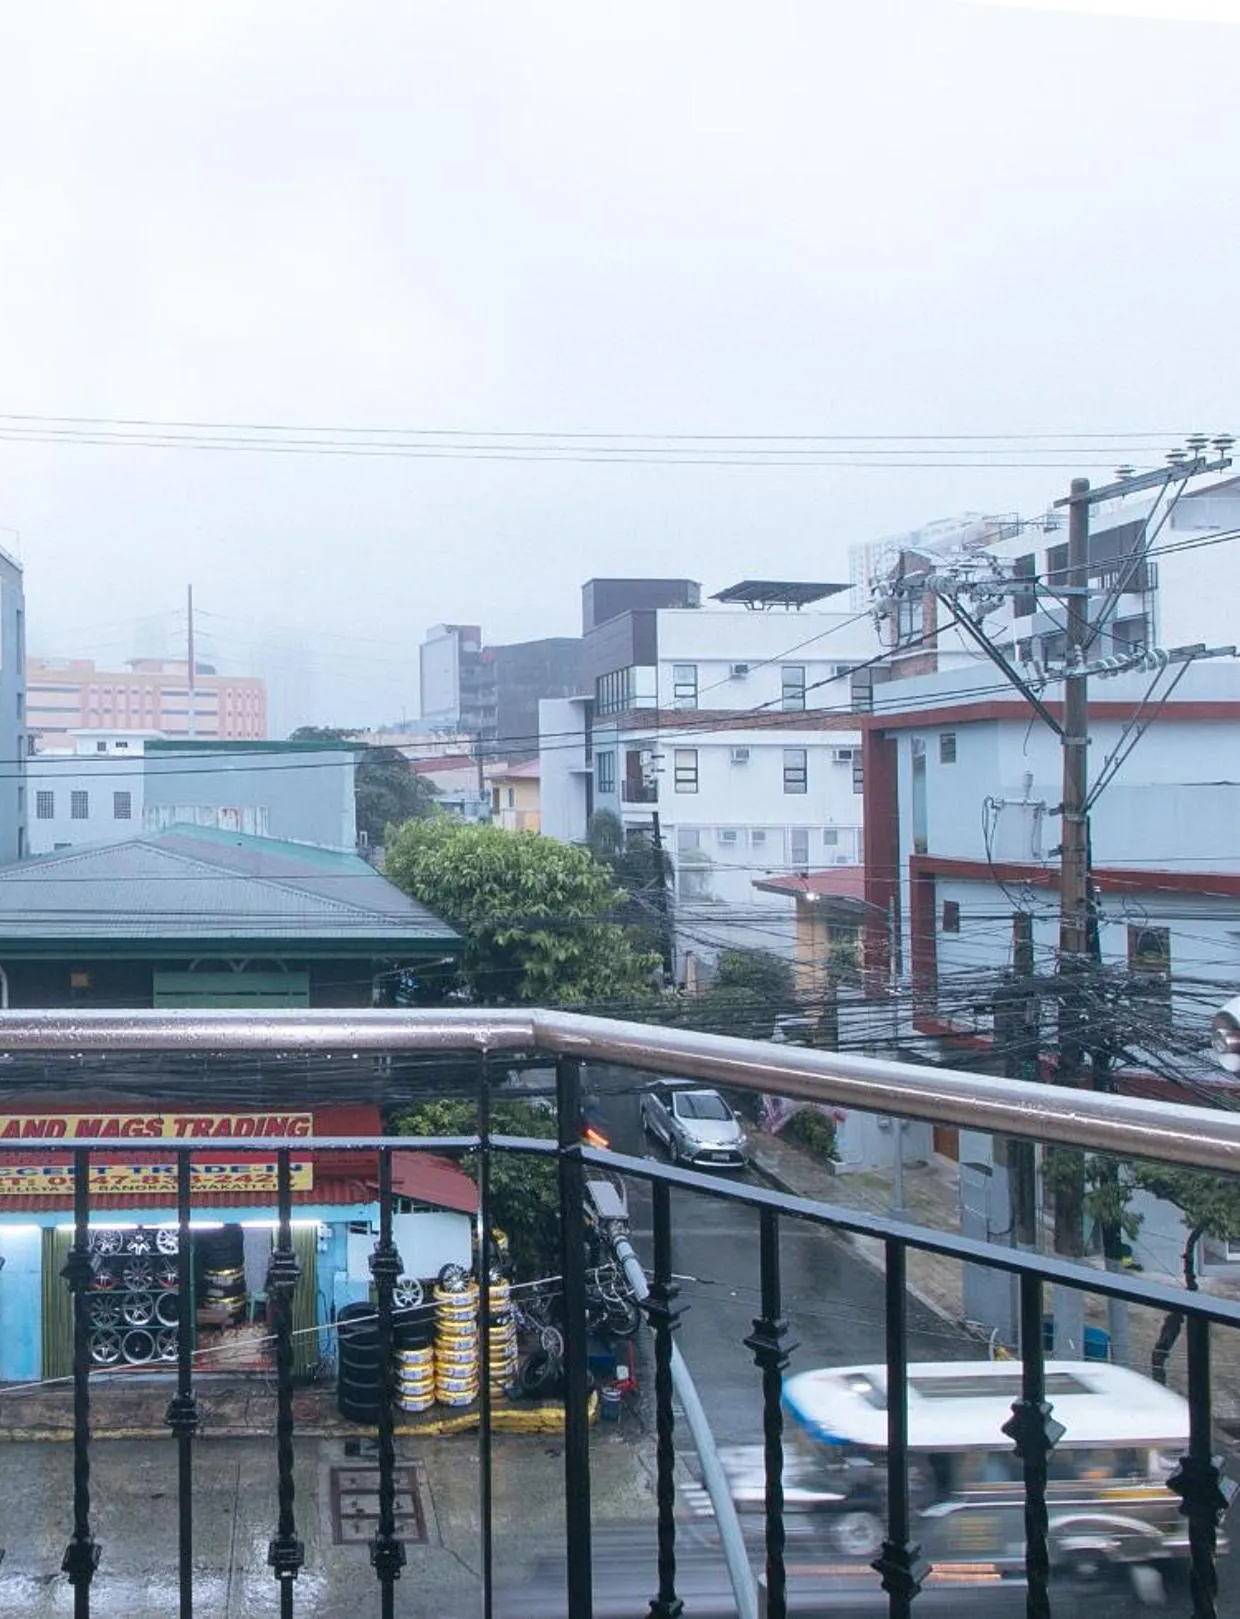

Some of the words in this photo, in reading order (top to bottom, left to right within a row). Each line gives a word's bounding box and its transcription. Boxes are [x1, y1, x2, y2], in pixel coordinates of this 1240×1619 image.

[1, 1119, 69, 1138] AND
[75, 1118, 165, 1138] MAGS
[173, 1117, 310, 1138] TRADING
